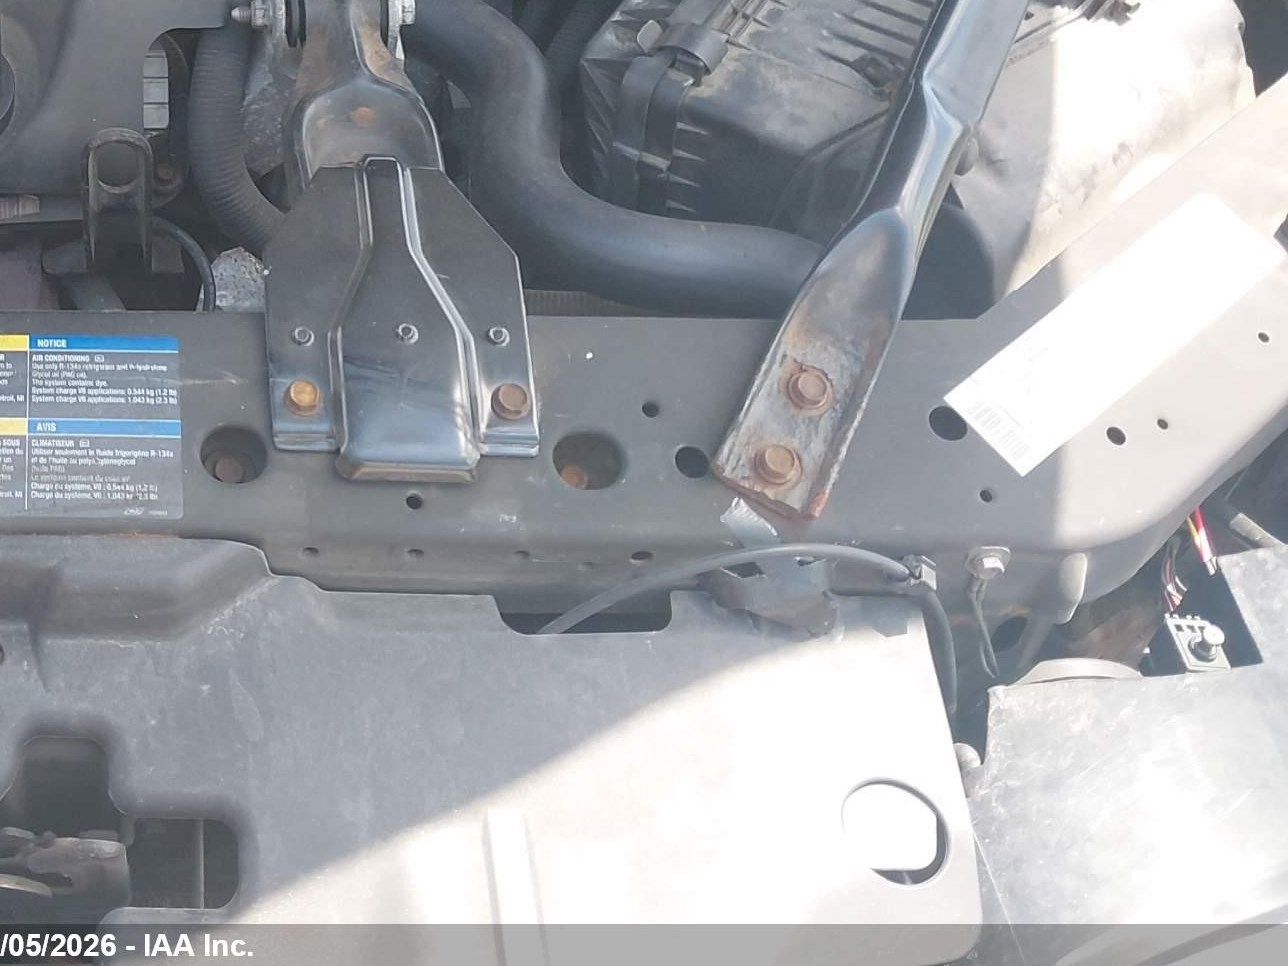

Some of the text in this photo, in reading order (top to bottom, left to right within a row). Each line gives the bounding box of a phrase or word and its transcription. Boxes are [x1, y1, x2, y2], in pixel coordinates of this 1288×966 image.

[38, 339, 67, 348] NOTICE
[32, 354, 90, 362] AIR CONDITIONING
[36, 422, 56, 432] AVIS
